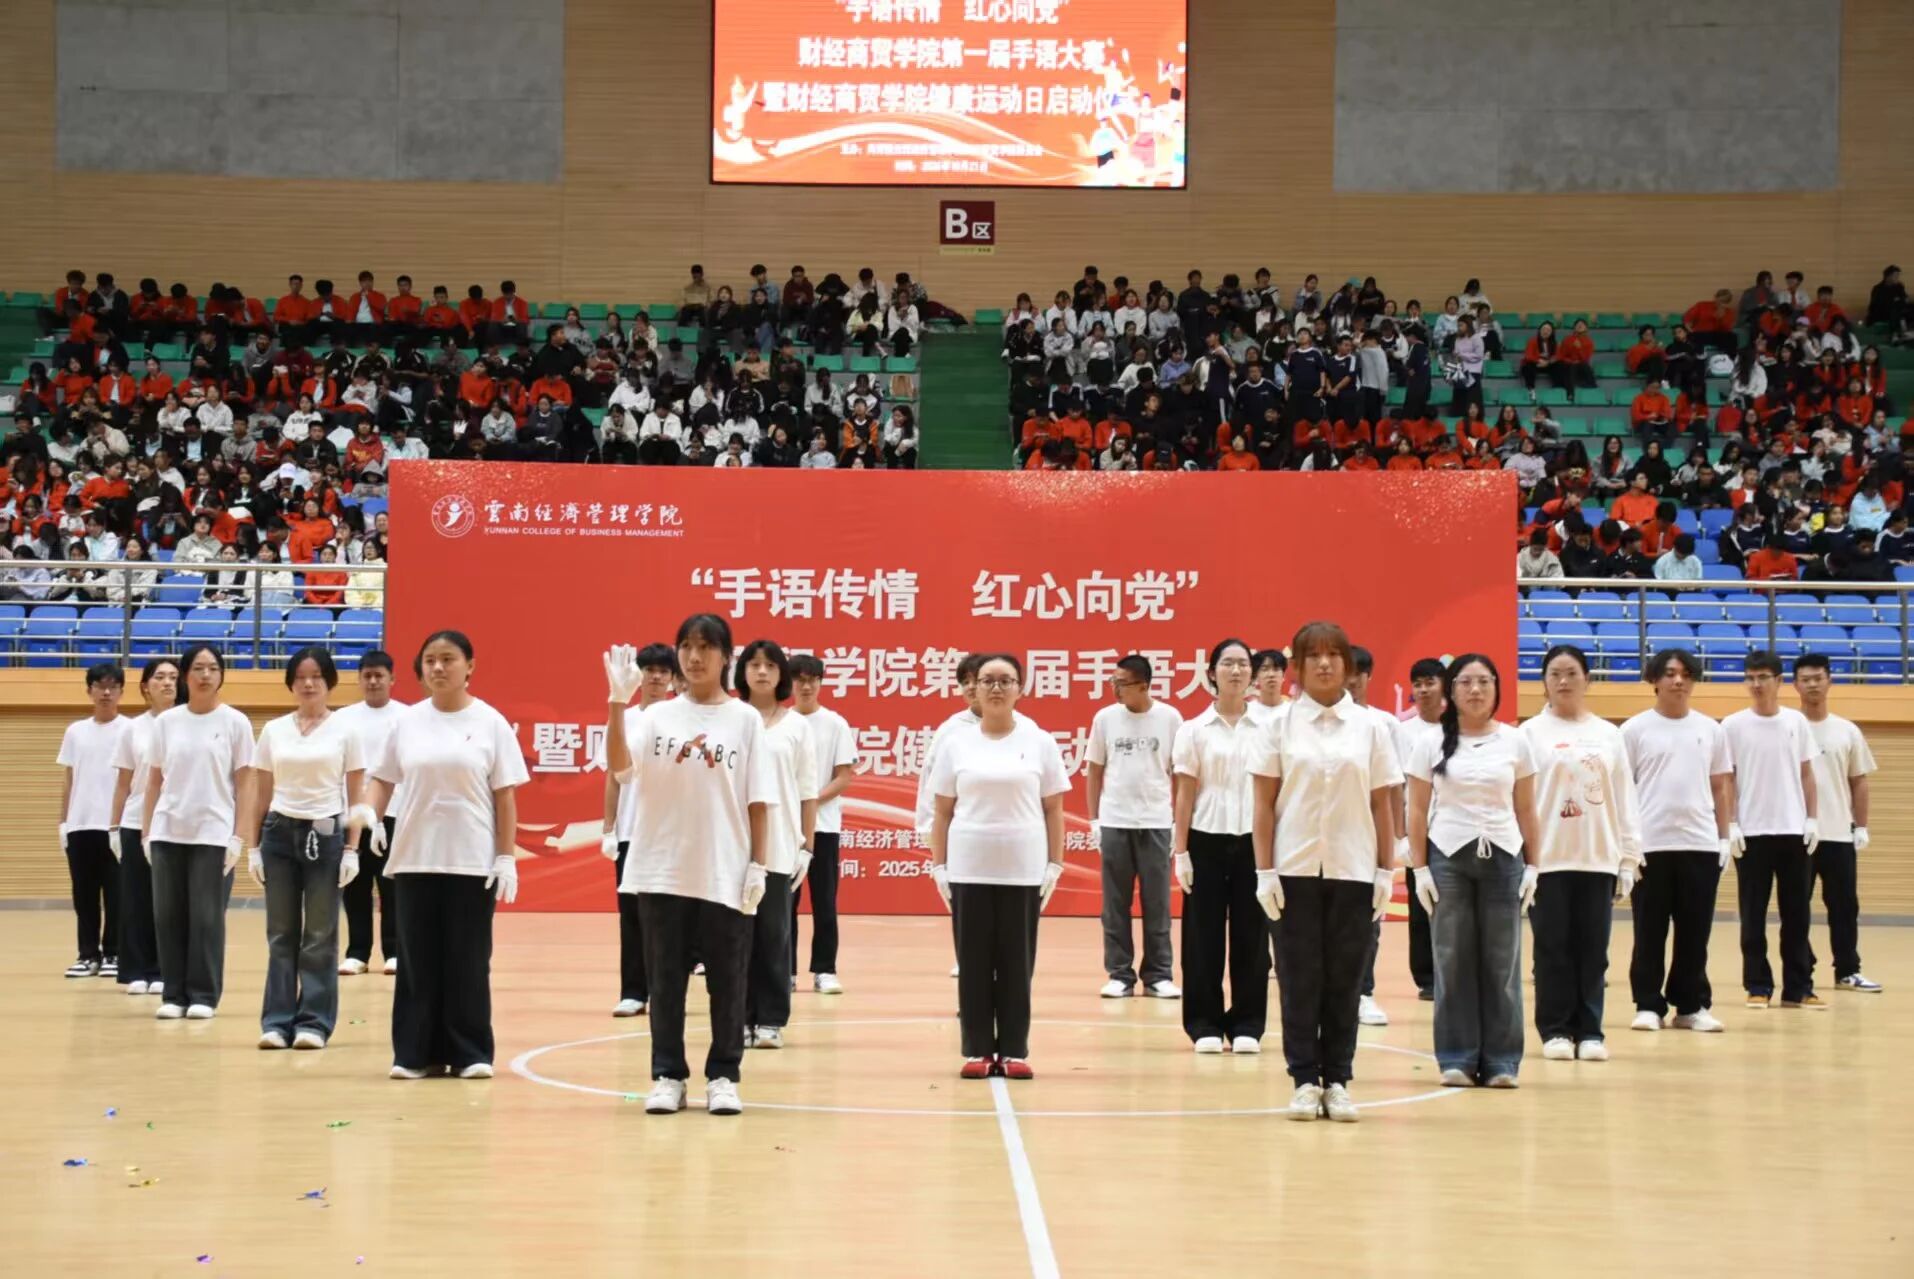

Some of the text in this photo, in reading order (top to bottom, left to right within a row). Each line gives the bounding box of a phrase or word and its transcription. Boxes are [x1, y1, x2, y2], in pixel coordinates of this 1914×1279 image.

[484, 527, 684, 537] YUNNAN COLLEGE OF BUSINESS MANAGEMENT
